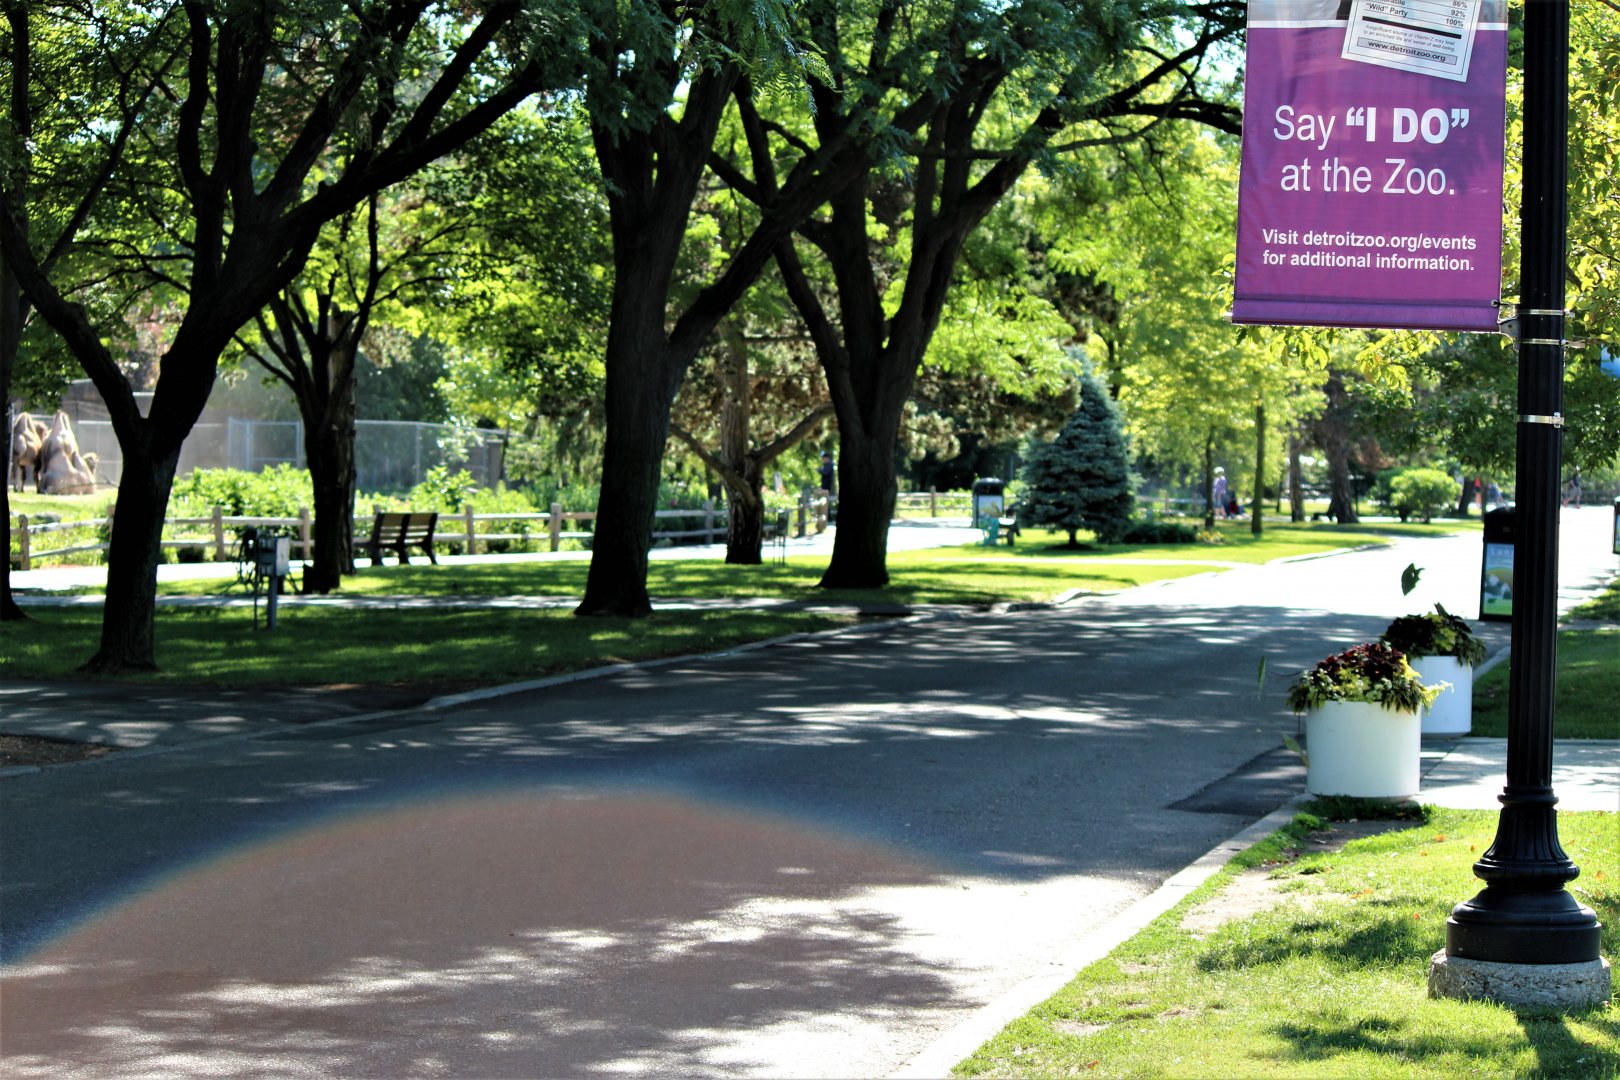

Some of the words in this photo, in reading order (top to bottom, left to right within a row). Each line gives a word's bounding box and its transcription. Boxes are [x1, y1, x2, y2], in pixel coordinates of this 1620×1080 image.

[1390, 7, 1409, 18] Party
[1451, 10, 1466, 18] 92%
[1453, 0, 1467, 8] 86%
[1446, 18, 1464, 27] 100%
[1368, 41, 1446, 61] www.detroitzoo.org
[1274, 104, 1336, 150] Say
[1345, 106, 1376, 142] “I
[1393, 107, 1470, 144] DO”
[1280, 158, 1311, 192] at
[1322, 157, 1372, 193] the
[1383, 158, 1455, 195] Zoo.
[1263, 228, 1298, 245] Visit
[1303, 230, 1477, 252] detroitzoo.org/events
[1263, 250, 1286, 265] for
[1290, 252, 1371, 268] additional
[1376, 255, 1475, 271] information.
